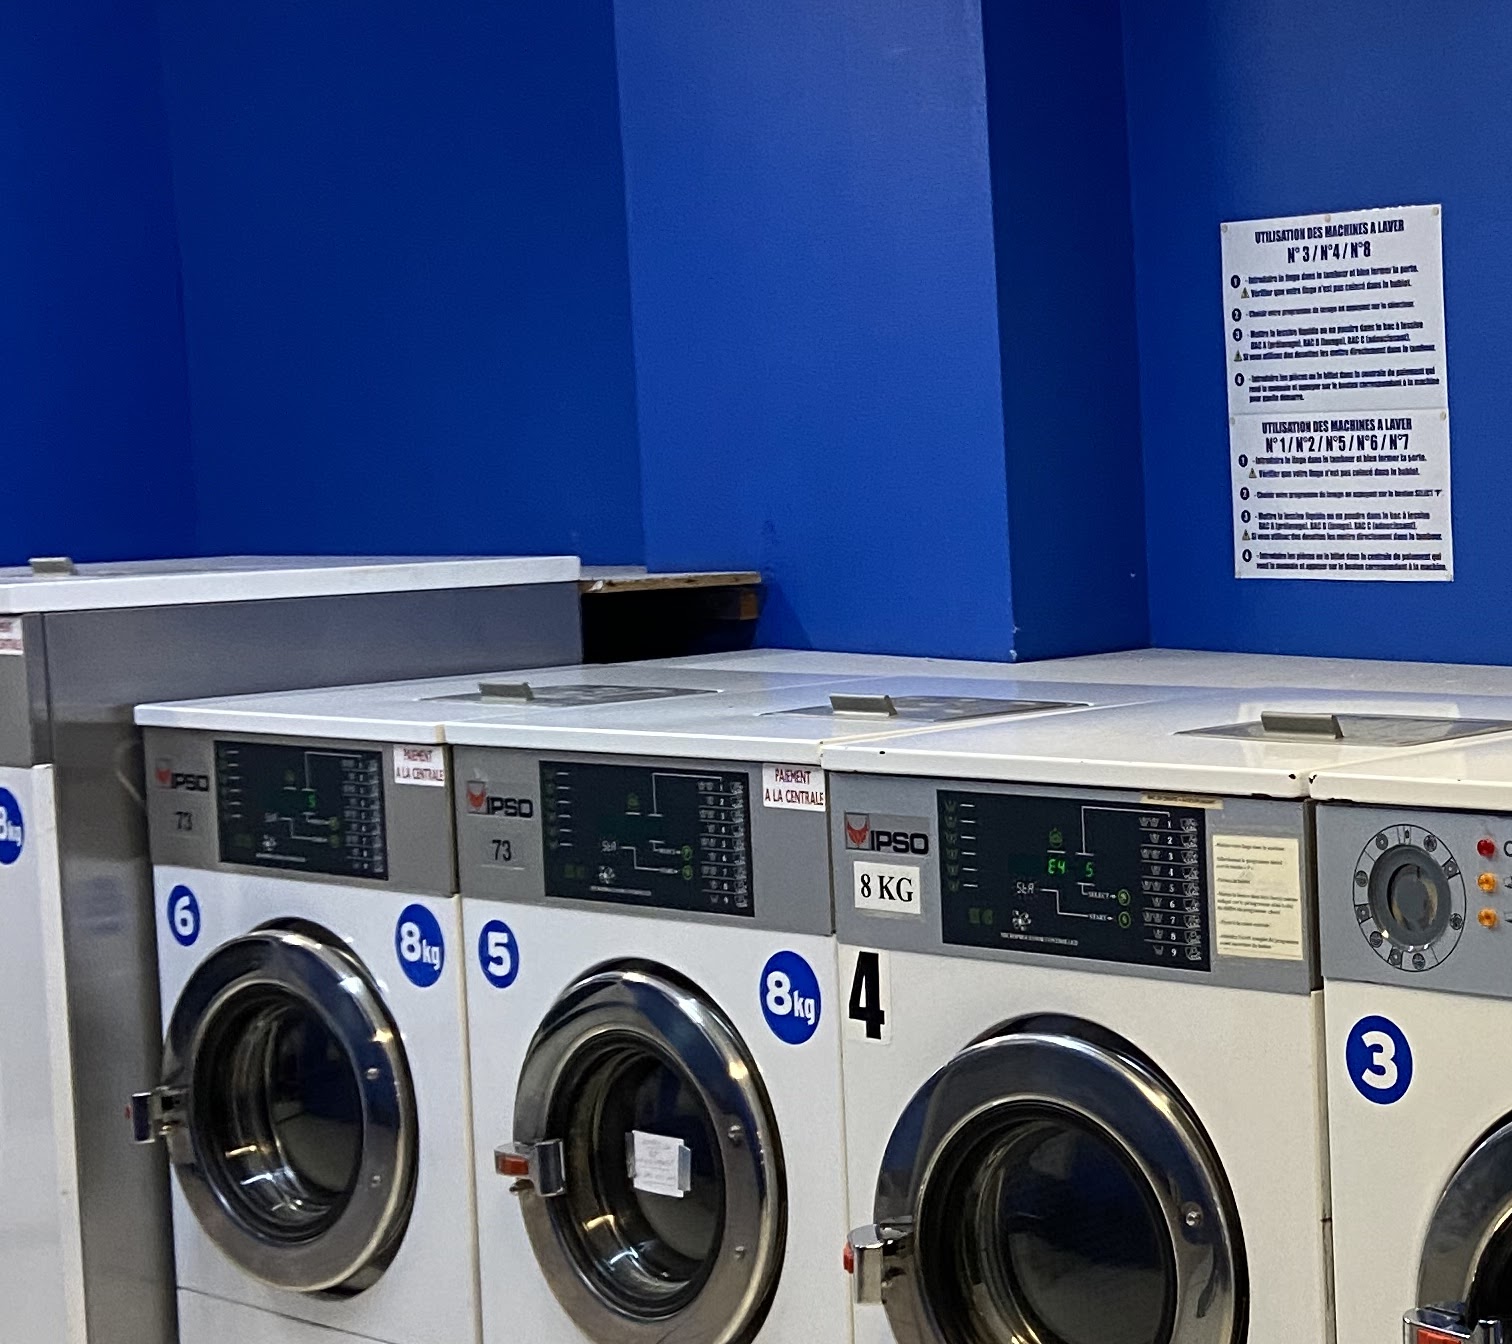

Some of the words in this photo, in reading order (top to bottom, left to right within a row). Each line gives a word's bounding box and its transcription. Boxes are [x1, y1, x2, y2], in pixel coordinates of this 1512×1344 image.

[1255, 227, 1305, 244] UTILISATION
[1306, 226, 1323, 239] DES
[1324, 222, 1368, 237] MACHINES
[1370, 221, 1376, 233] A
[1377, 219, 1404, 233] LAVER
[1302, 246, 1310, 262] 3
[1262, 421, 1311, 434] UTILISATION
[1313, 420, 1329, 432] DES
[1330, 419, 1376, 432] MACHINES
[1377, 419, 1384, 430] A
[1385, 418, 1412, 430] LAVER
[775, 768, 811, 785] PAIEMENT
[487, 795, 533, 818] IPSO
[765, 788, 771, 801] A
[773, 788, 783, 802] LA
[786, 789, 824, 805] CENTRALE
[175, 811, 193, 831] 73
[492, 839, 511, 861] 73
[870, 830, 929, 855] IPSO
[860, 874, 872, 898] 8
[878, 875, 914, 903] KG
[174, 895, 194, 937] 6
[400, 921, 441, 969] 8kg
[487, 932, 511, 977] 5
[766, 970, 815, 1026] 8kg
[849, 950, 885, 1040] 4
[1361, 1031, 1398, 1089] 3
